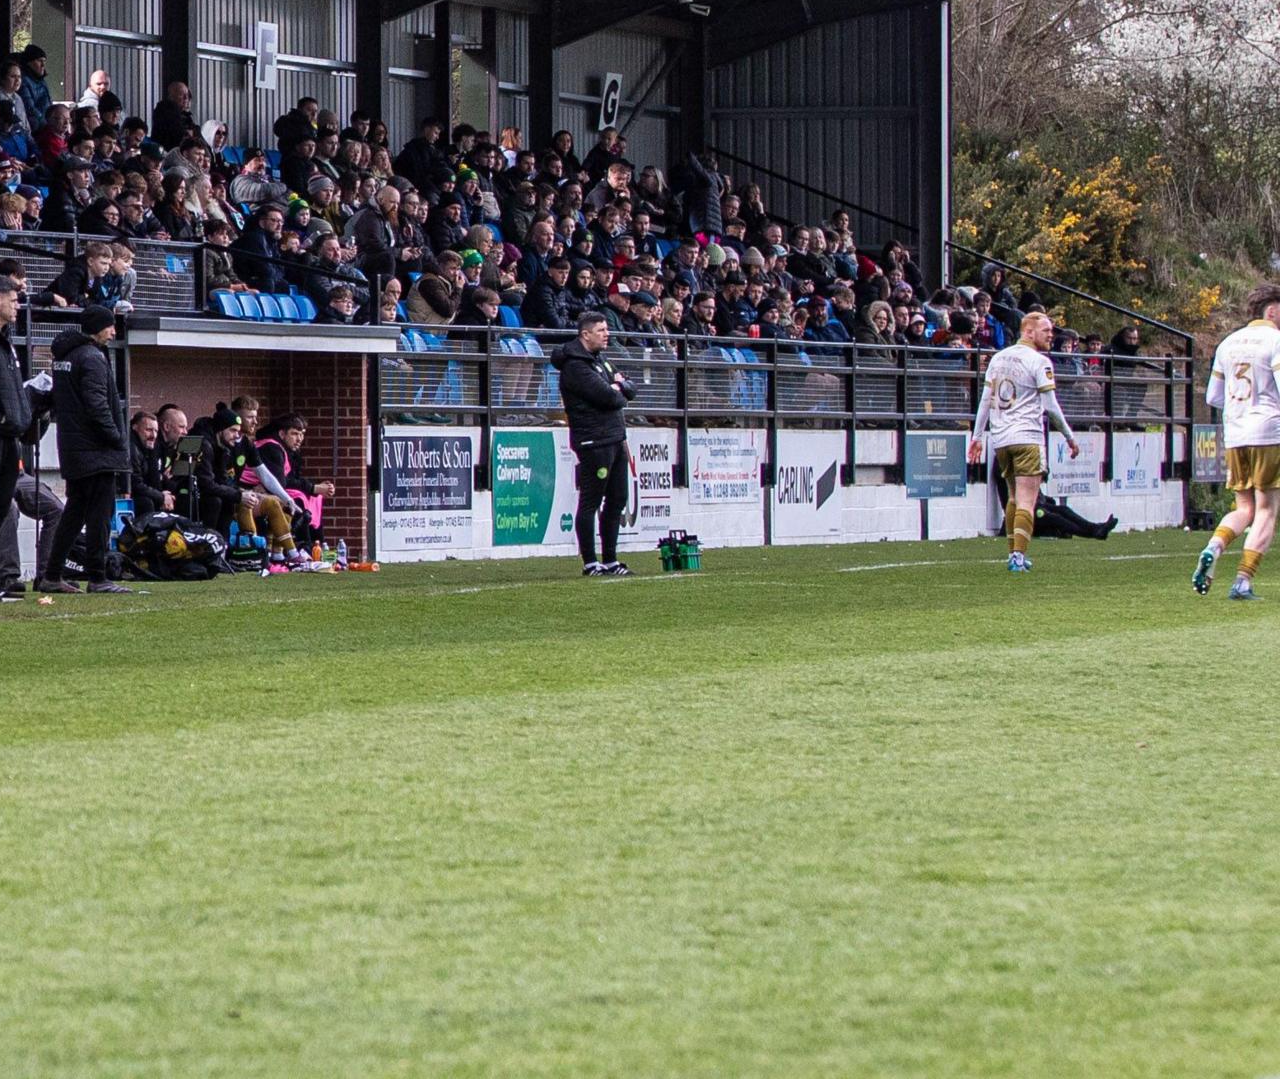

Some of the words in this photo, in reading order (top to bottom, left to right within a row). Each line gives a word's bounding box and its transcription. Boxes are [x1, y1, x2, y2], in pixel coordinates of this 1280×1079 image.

[260, 29, 274, 81] F
[603, 79, 619, 125] G
[383, 441, 392, 469] R
[392, 441, 406, 469] W
[407, 440, 441, 469] Roberts
[442, 441, 451, 469] &
[453, 440, 471, 469] Son
[496, 443, 530, 464] Specsavers
[639, 443, 669, 462] ROOFING
[1195, 431, 1217, 459] KHS
[496, 464, 520, 485] Colwyn
[520, 464, 532, 485] Bay
[639, 472, 671, 490] SERVICES
[778, 466, 814, 505] CARLING
[496, 512, 519, 533] Colwyn
[519, 512, 531, 533] Bay
[531, 511, 539, 529] FC
